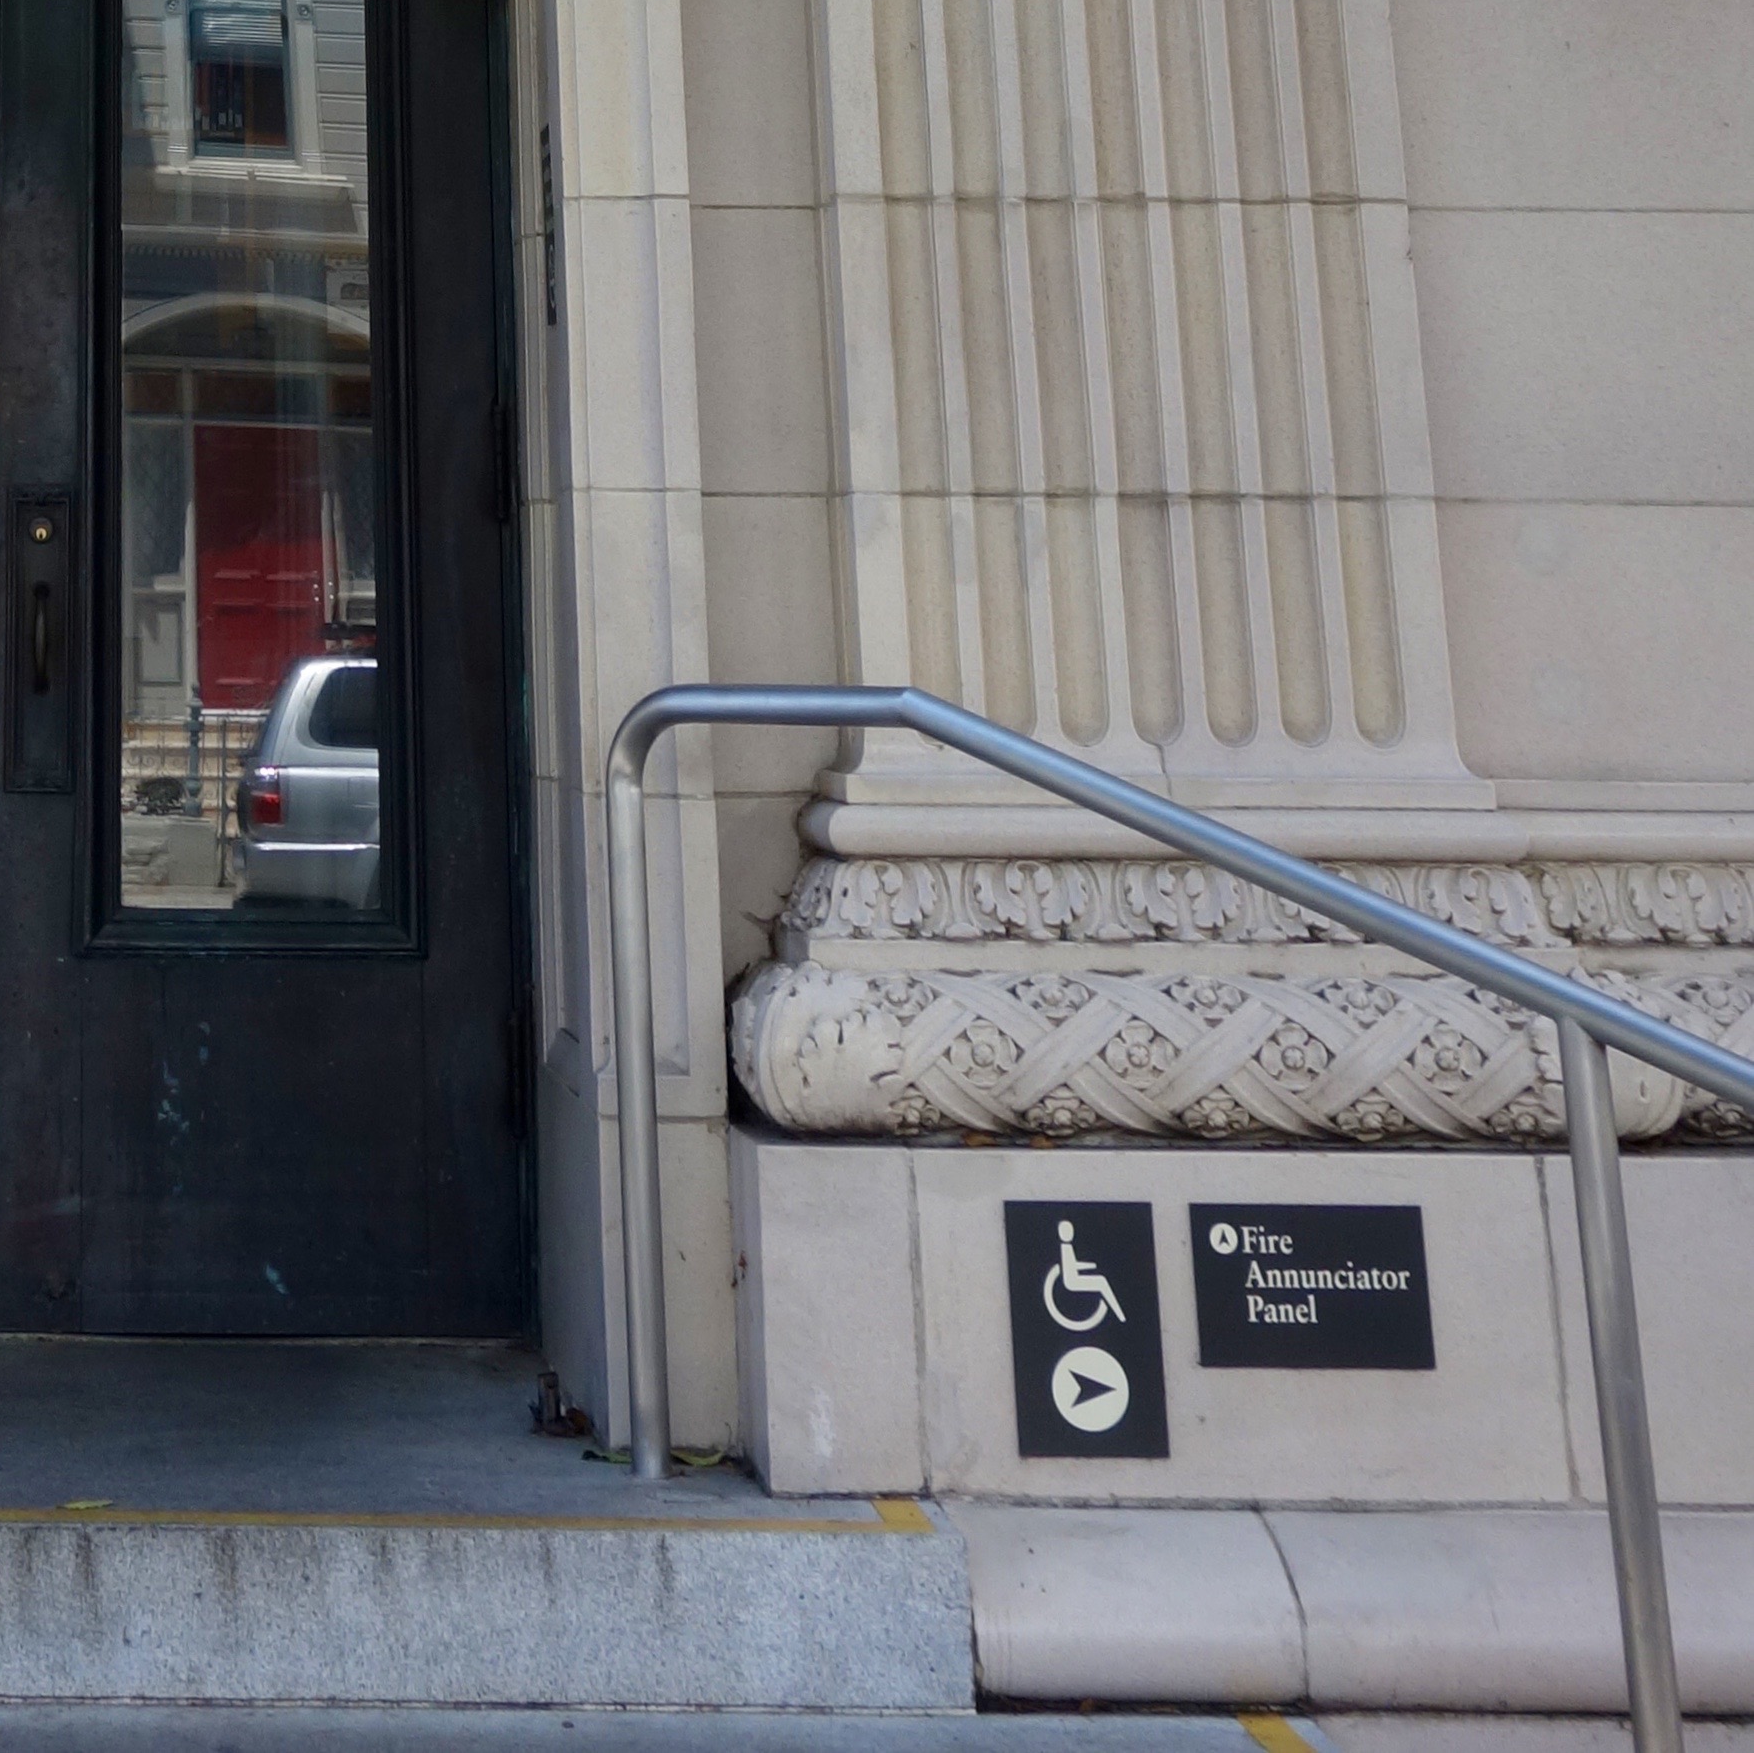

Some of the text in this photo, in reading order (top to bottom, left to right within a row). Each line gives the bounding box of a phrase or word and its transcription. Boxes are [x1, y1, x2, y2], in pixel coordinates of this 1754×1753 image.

[1241, 1225, 1294, 1255] Fire
[1245, 1260, 1411, 1290] Annunciator
[1247, 1294, 1319, 1324] Panel
